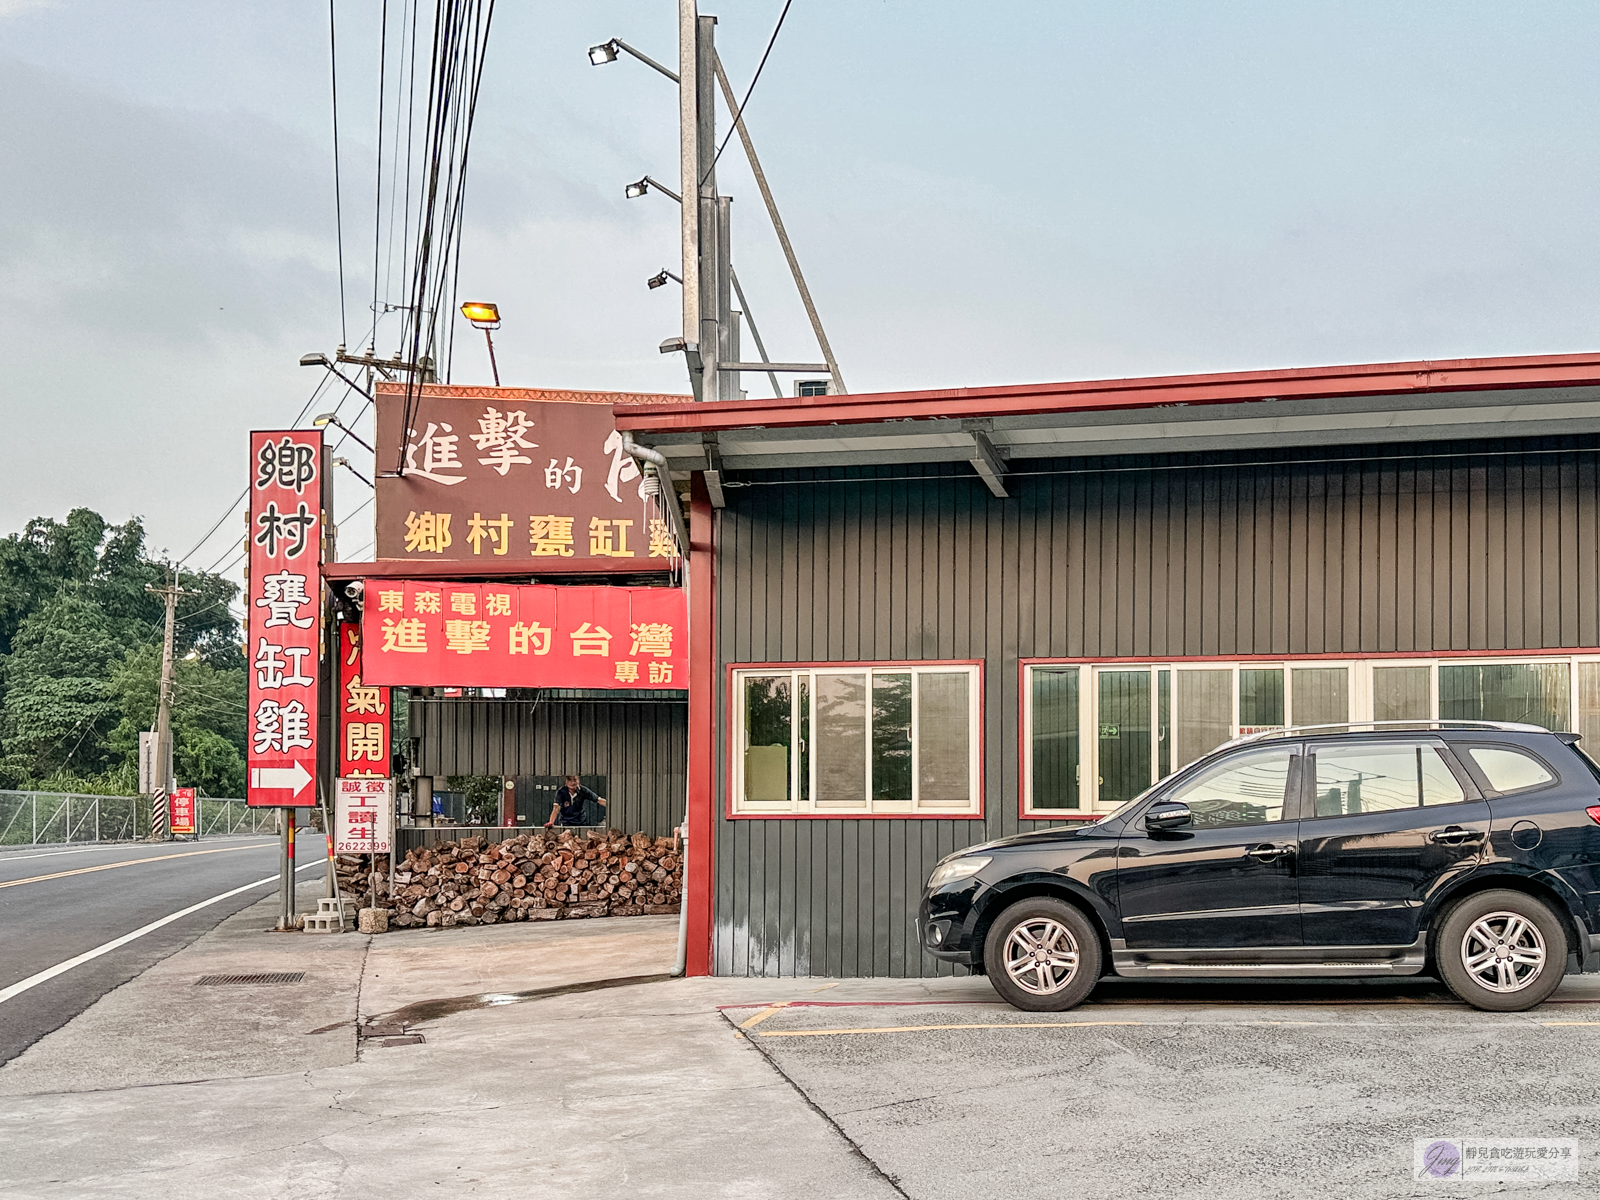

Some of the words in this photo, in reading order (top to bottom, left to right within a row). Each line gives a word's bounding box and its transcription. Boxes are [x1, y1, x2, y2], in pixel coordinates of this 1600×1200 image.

[254, 438, 316, 754] 鄉村甕缸雞
[378, 590, 512, 616] 東森電視
[380, 617, 674, 658] 進擊的台灣
[614, 661, 674, 684] 專訪
[346, 629, 385, 778] 氣開
[174, 797, 190, 826] 停車場
